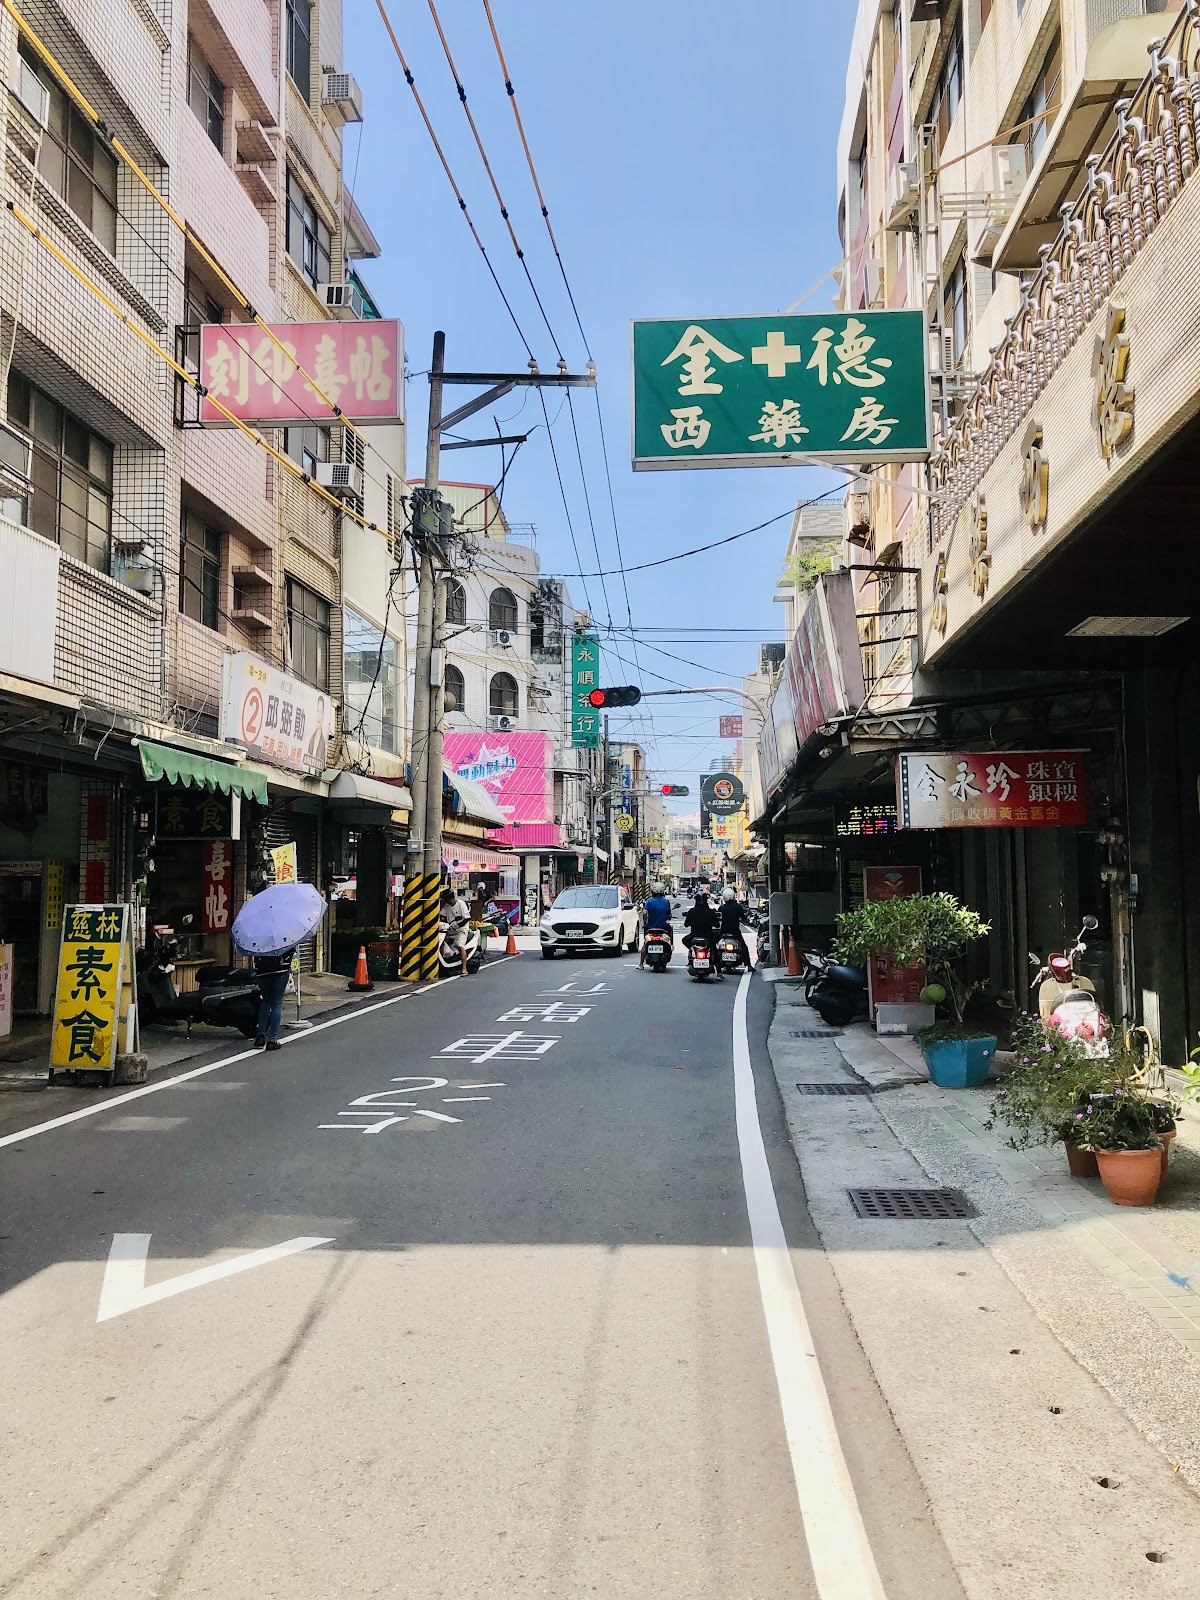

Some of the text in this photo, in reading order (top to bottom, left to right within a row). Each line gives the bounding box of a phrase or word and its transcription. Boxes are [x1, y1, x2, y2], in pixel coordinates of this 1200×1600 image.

[205, 333, 393, 406] 刻印喜帖
[659, 396, 900, 450] 西藥房
[576, 647, 596, 732] 永順茶行
[1026, 760, 1077, 781] 珠寶
[1027, 782, 1078, 803] 銀樓
[204, 839, 232, 929] 喜帖
[61, 945, 114, 1063] 素食
